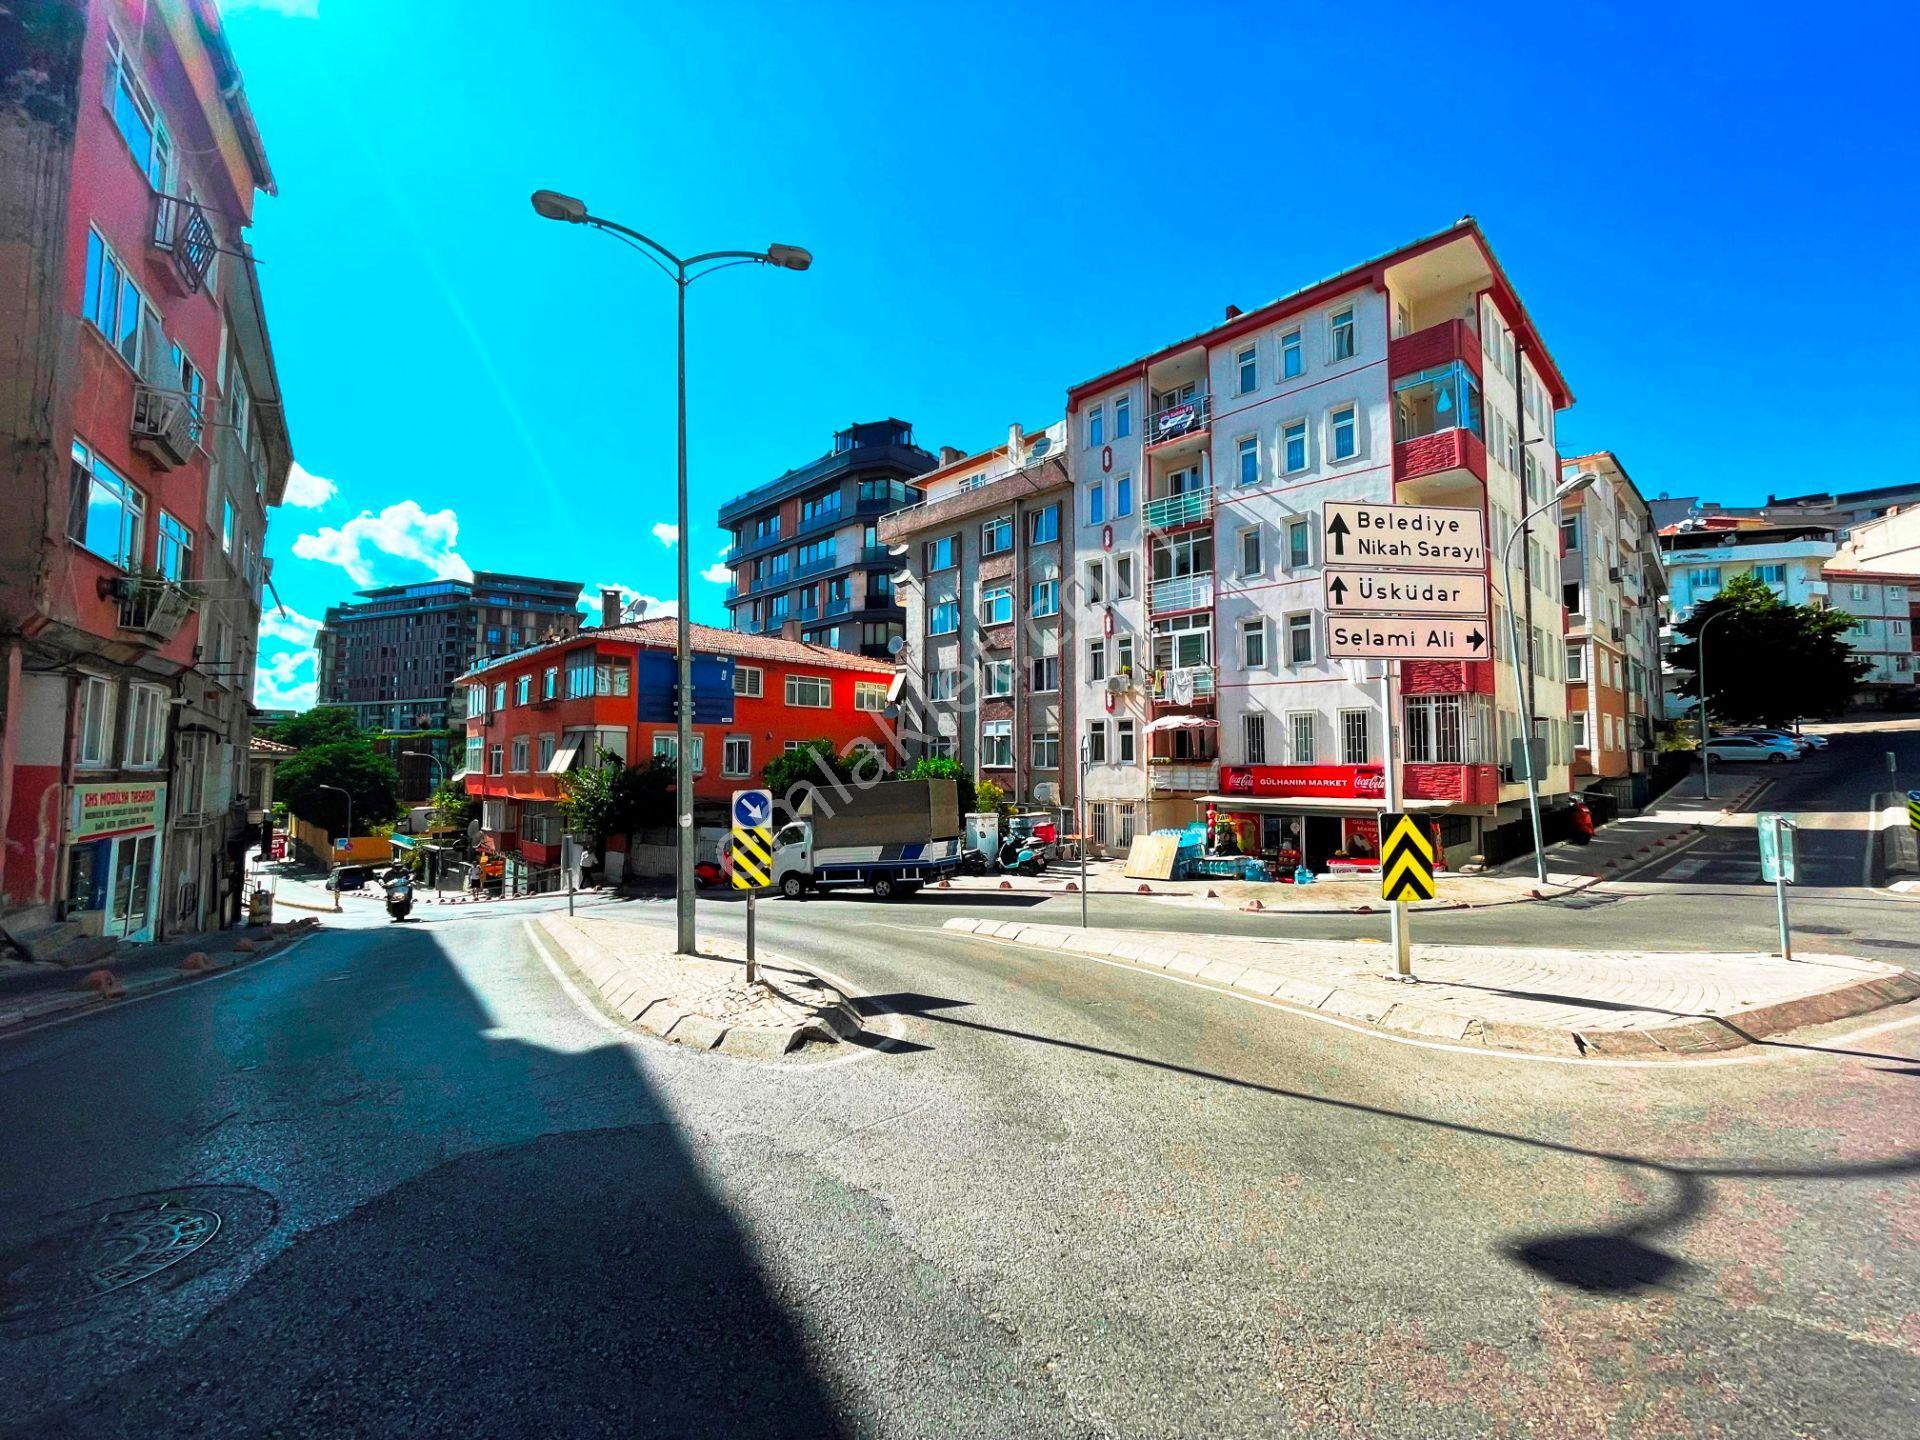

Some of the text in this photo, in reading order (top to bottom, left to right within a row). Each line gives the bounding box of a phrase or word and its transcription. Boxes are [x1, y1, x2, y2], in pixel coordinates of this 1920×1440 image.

[1357, 511, 1460, 536] Belediye
[1358, 539, 1480, 562] Nikah Sarayı
[1359, 577, 1460, 602] Üsküdar
[1334, 628, 1454, 648] Selami Ali
[1260, 777, 1348, 787] GÜLHANIM MARKET
